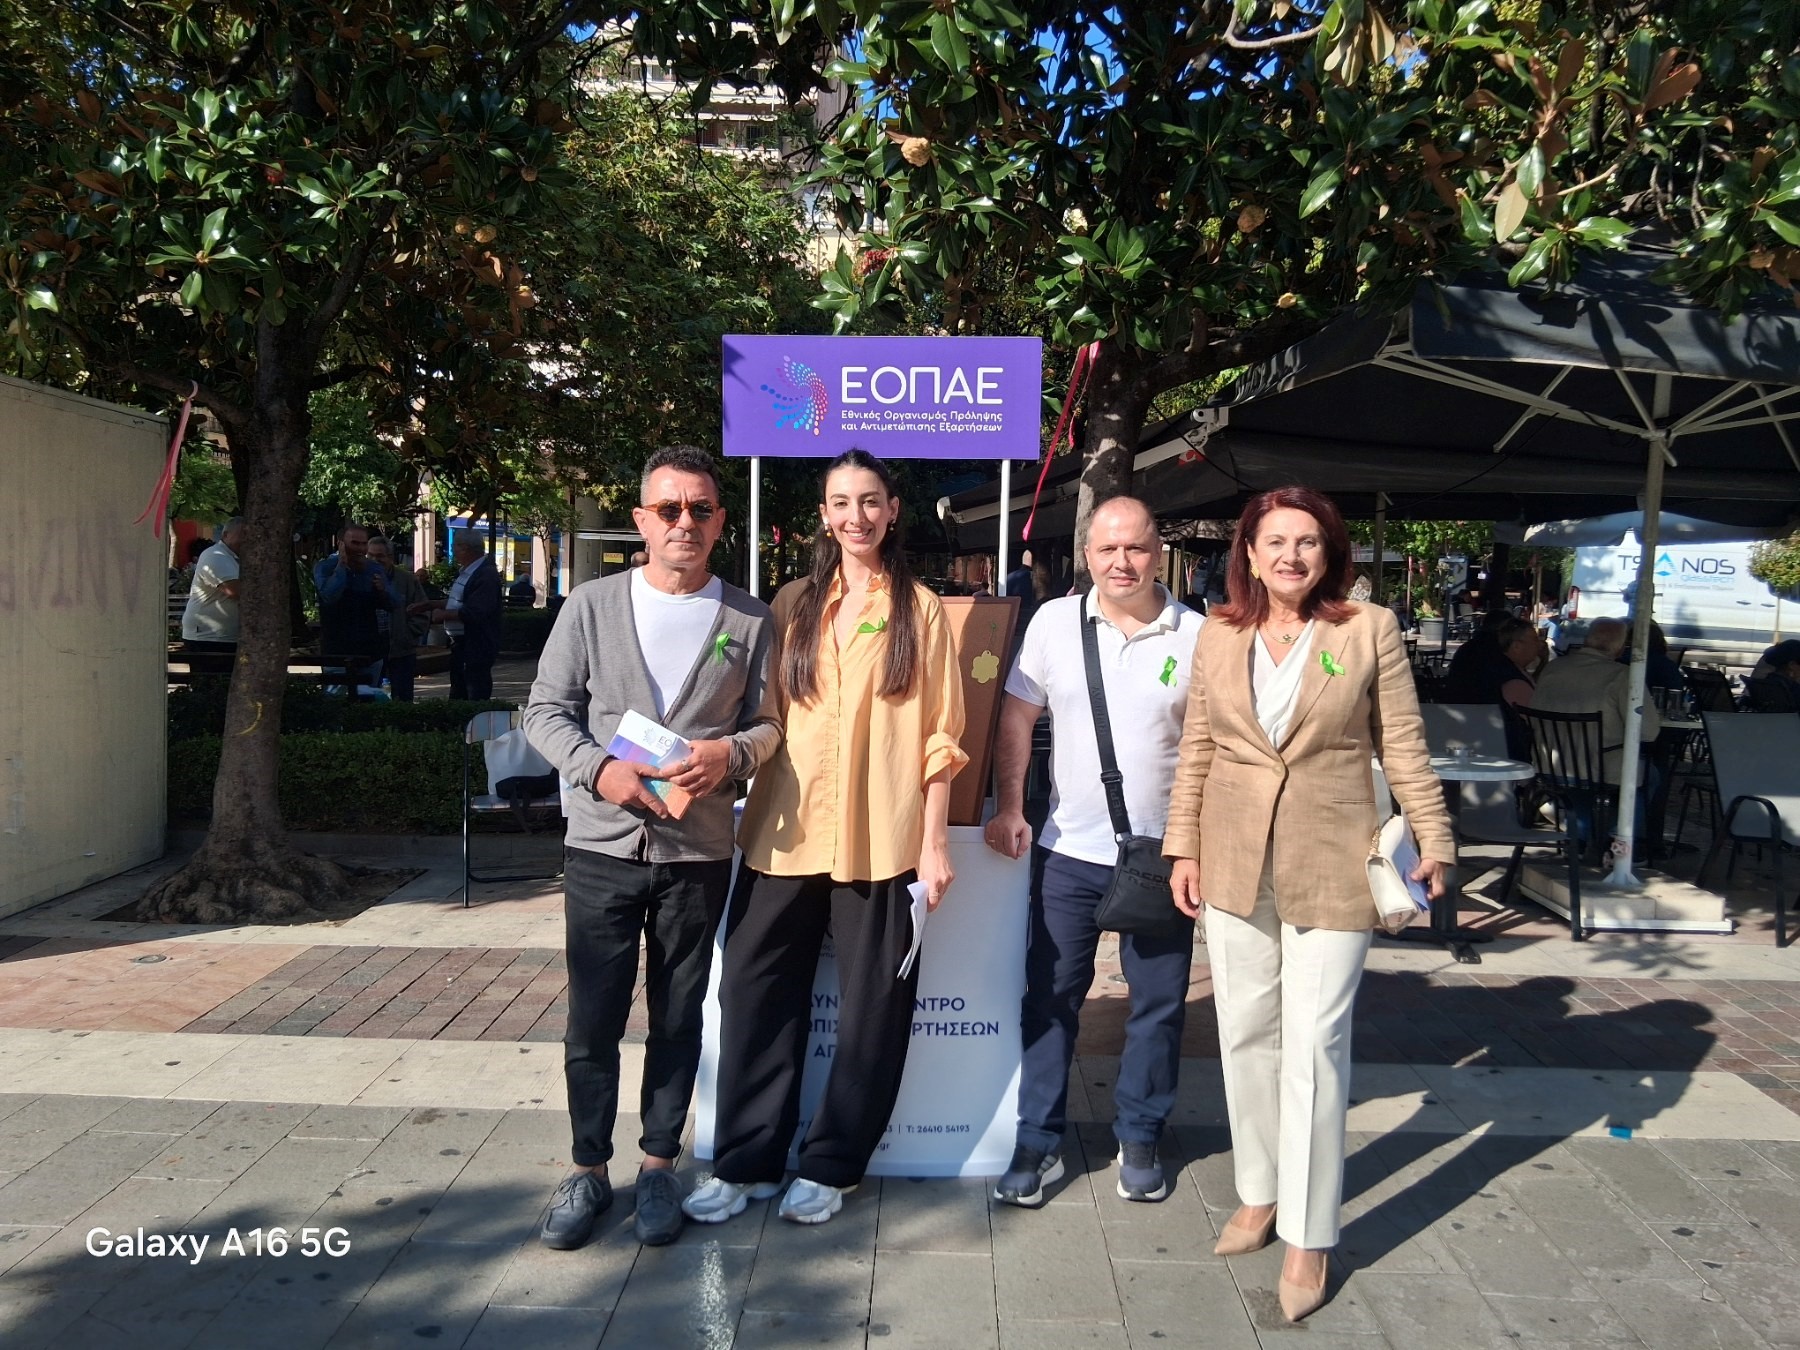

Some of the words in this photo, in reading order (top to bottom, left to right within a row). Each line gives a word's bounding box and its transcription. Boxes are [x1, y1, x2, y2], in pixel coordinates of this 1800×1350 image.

[841, 365, 1004, 405] ΕΟΠΑΕ
[841, 409, 881, 421] Εθνικός
[883, 409, 947, 421] Οργανισμός
[950, 410, 1003, 422] Πρόληψης
[841, 422, 858, 431] και
[860, 421, 936, 432] Αντιμετώπισης
[939, 421, 1003, 433] Εξαρτήσεων
[1109, 783, 1123, 818] REPL
[913, 997, 965, 1012] ΝΤΡΟ
[912, 1021, 999, 1036] ΡΤΗΣΕΩΝ
[917, 1124, 943, 1133] 26410
[945, 1124, 970, 1133] 54193
